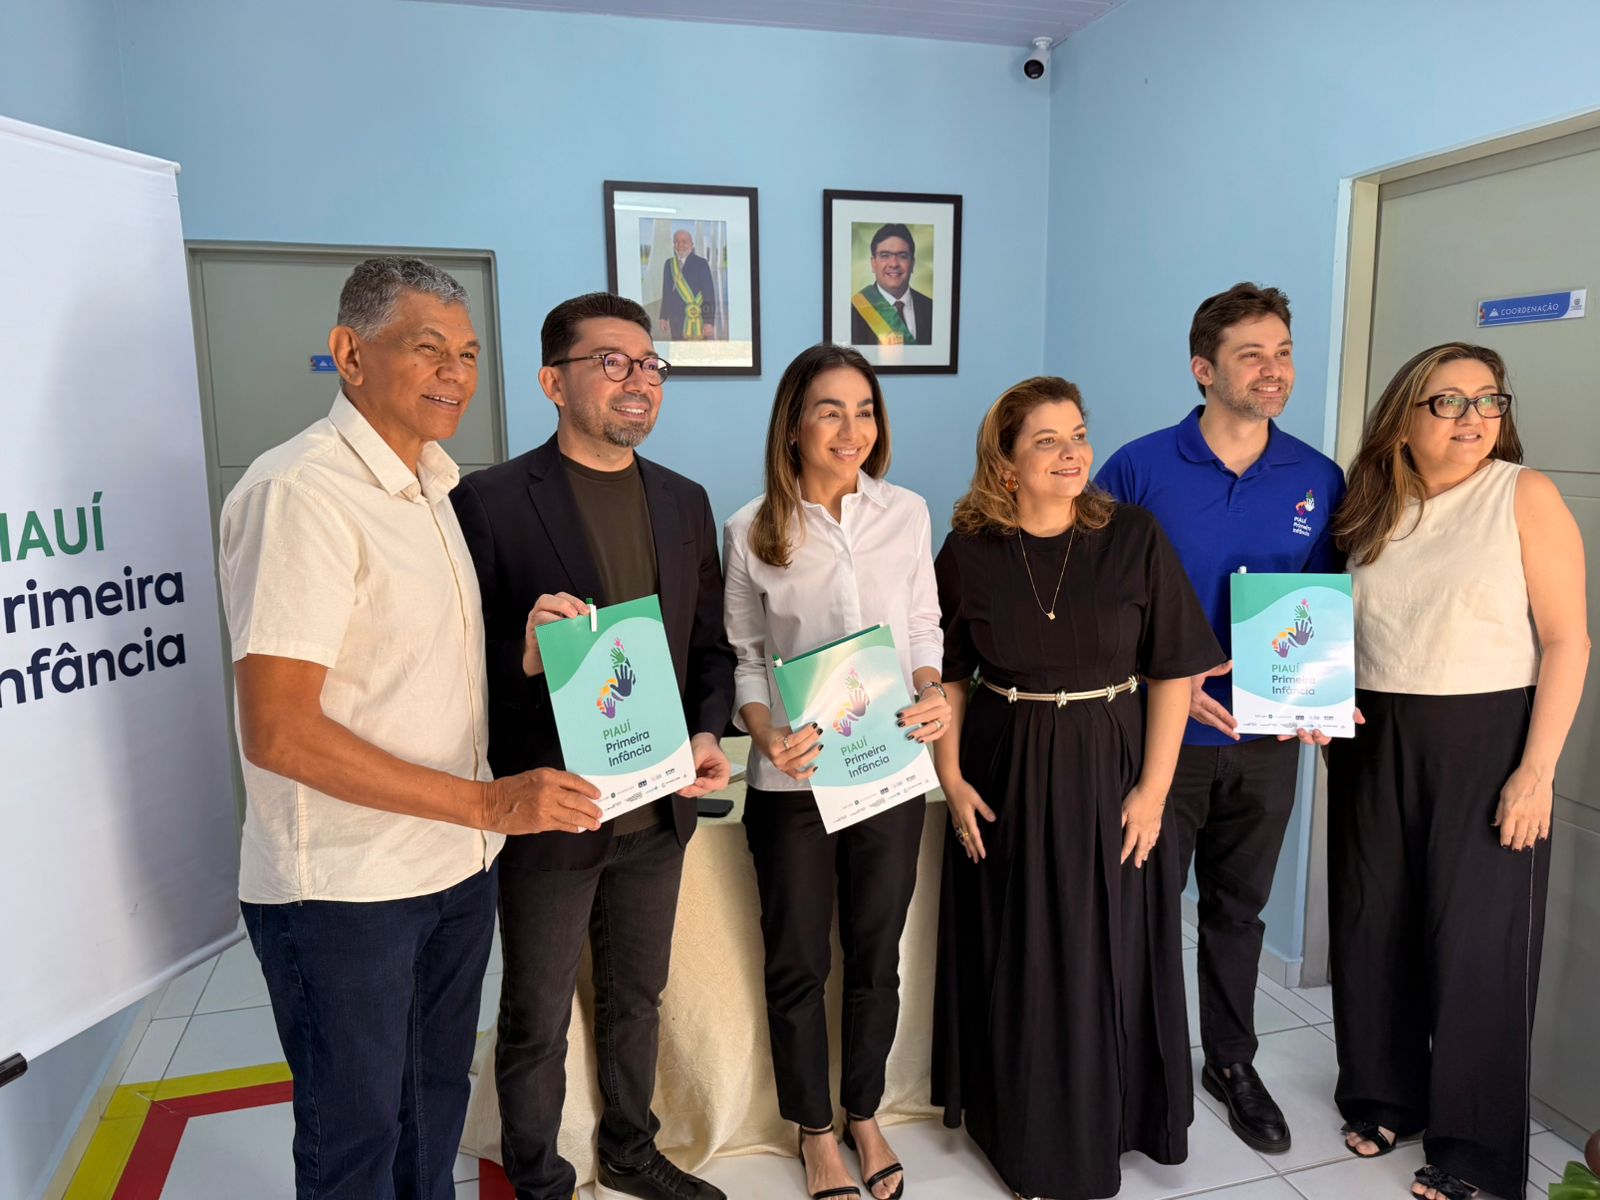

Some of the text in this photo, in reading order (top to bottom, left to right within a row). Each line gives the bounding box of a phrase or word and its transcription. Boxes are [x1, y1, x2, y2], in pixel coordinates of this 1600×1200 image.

[1500, 302, 1559, 316] COORDENAÇÃO
[0, 491, 104, 562] IAUÍ
[3, 566, 185, 634] rimeira
[0, 627, 186, 708] nfância
[1271, 662, 1300, 673] PIAUÍ
[603, 719, 631, 740] PIAUÍ
[606, 731, 650, 754] Primeira
[840, 736, 867, 756] PIAUÍ
[608, 744, 652, 767] Infância
[844, 744, 887, 767] Primeira
[848, 755, 890, 778] Infância
